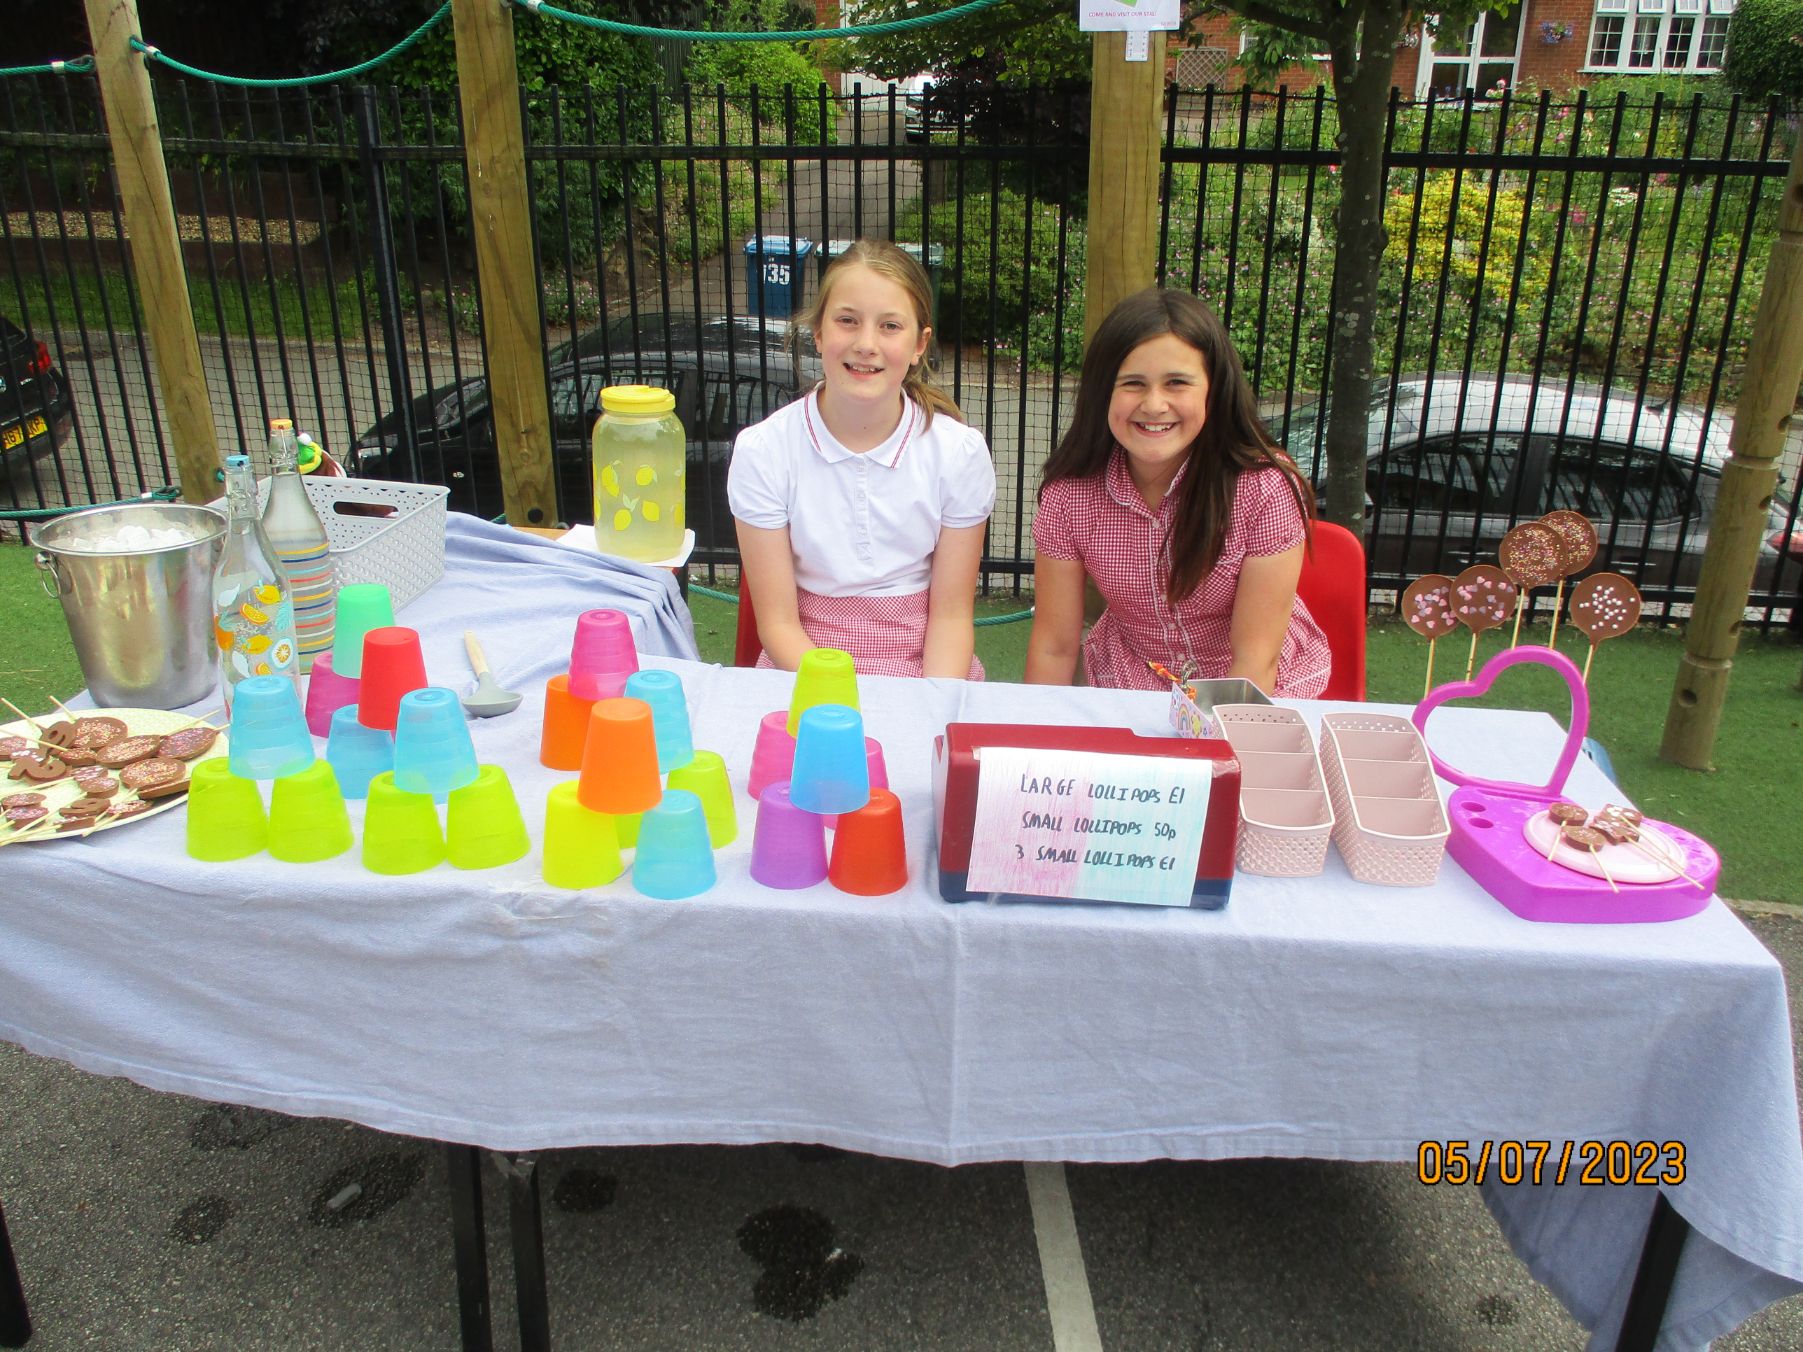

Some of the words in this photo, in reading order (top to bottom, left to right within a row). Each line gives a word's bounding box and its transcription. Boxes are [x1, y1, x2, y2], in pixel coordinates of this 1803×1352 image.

[1020, 773, 1076, 796] LARGE
[1088, 783, 1161, 803] LOLLIPOPS
[1022, 811, 1062, 832] SMALL
[1073, 816, 1142, 835] LOLLIPOPS
[1154, 822, 1176, 841] 50p
[1015, 844, 1025, 860] 3
[1036, 845, 1078, 863] SMALL
[1084, 850, 1156, 869] LOLLIPOPS
